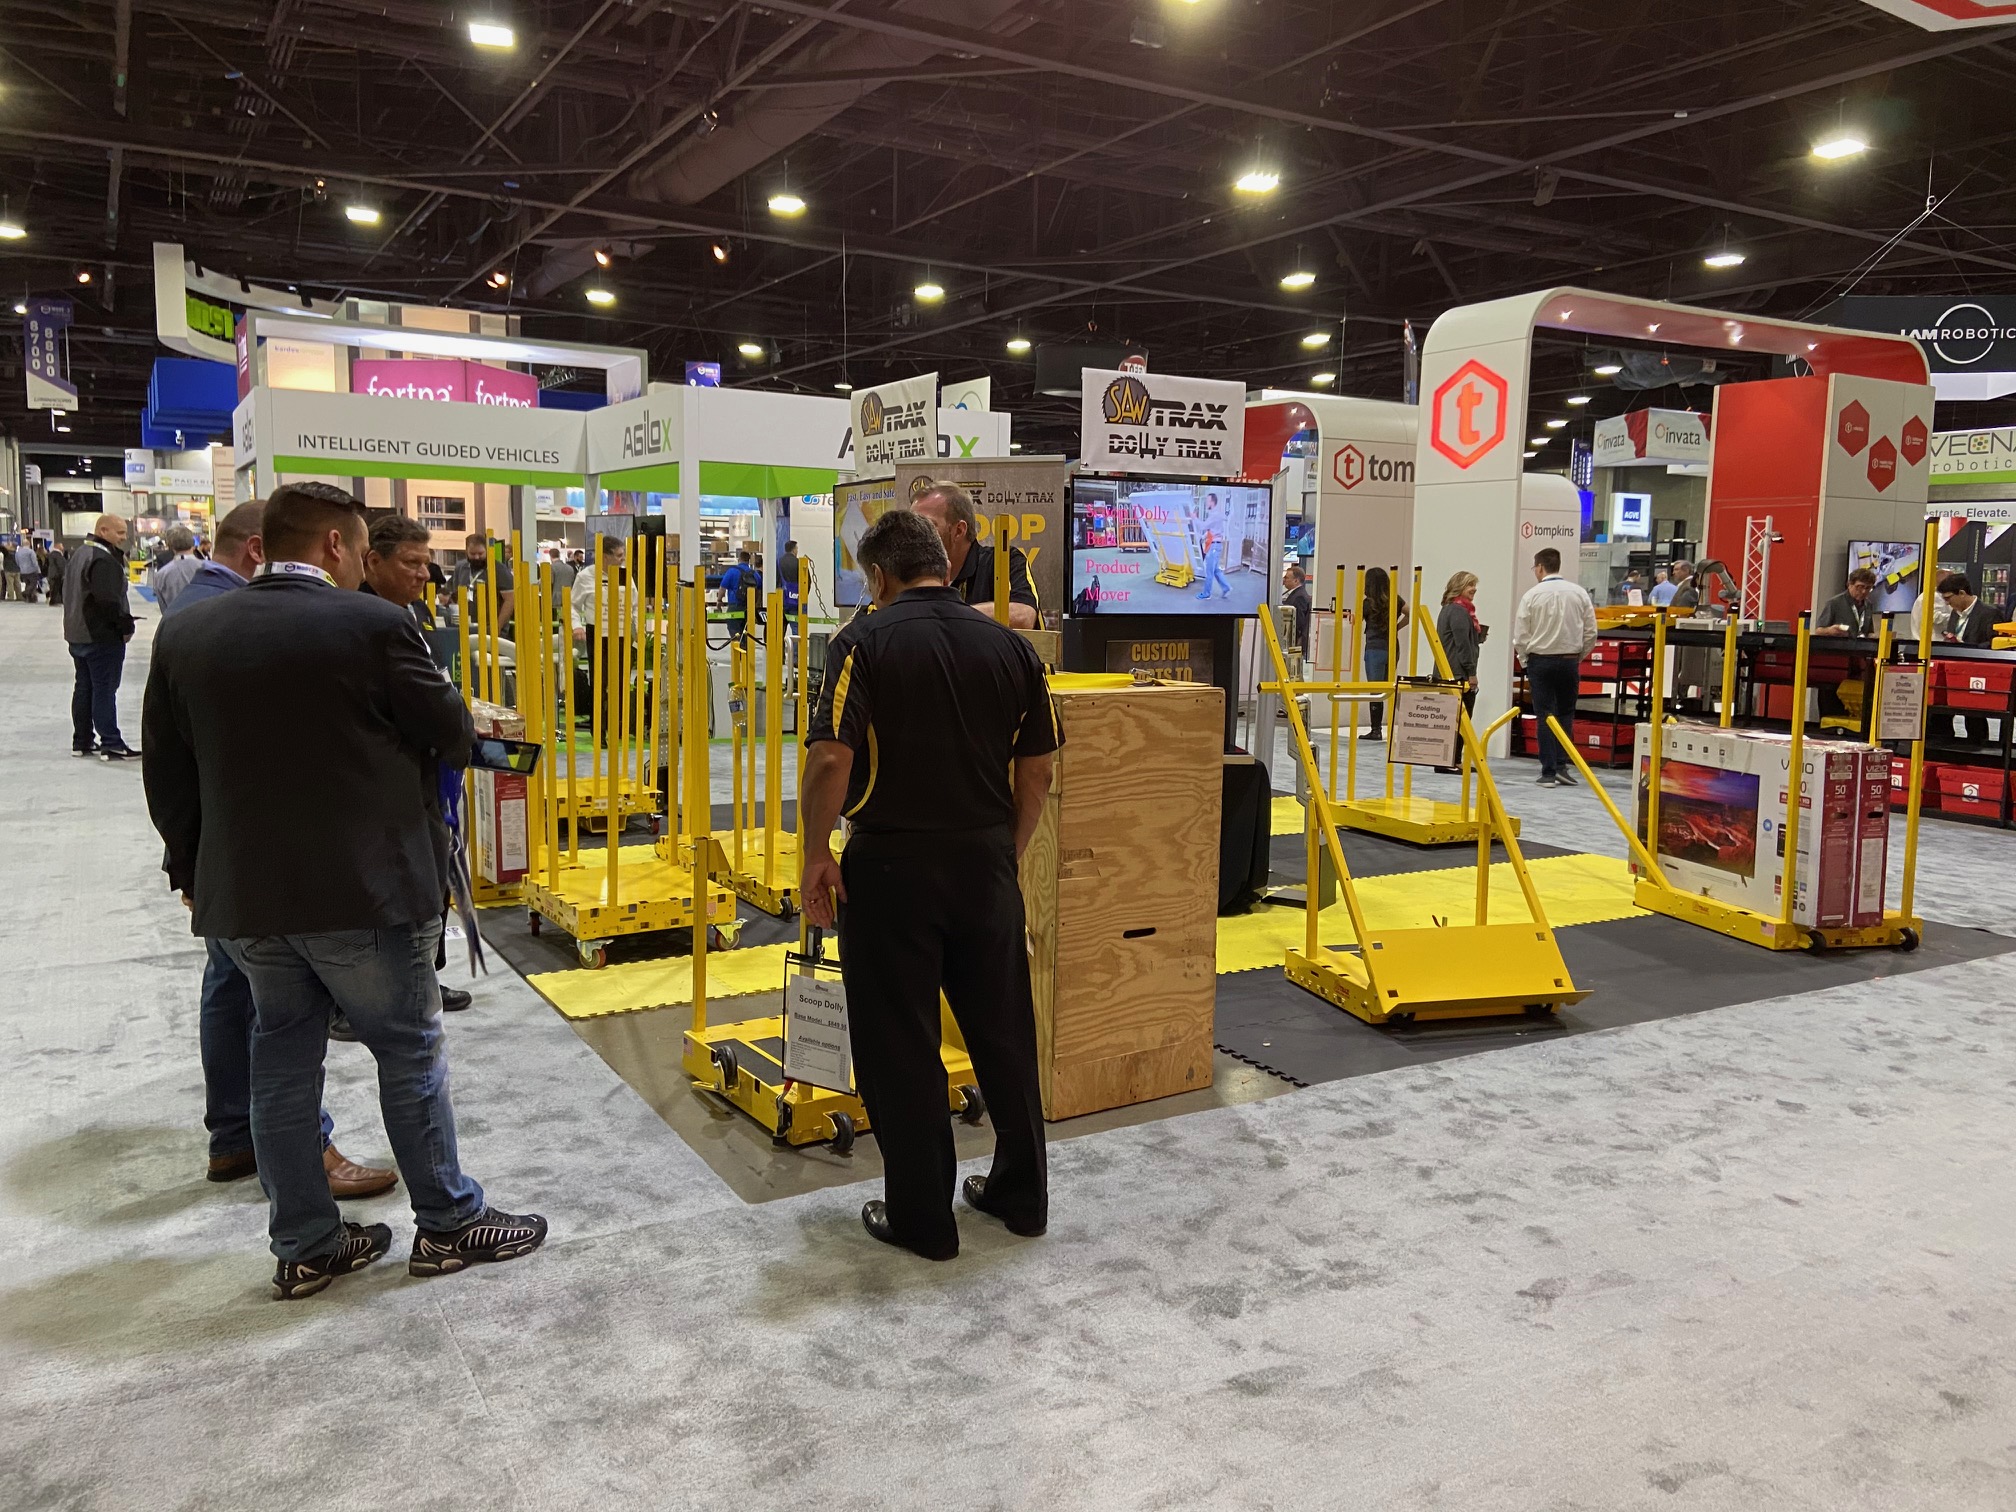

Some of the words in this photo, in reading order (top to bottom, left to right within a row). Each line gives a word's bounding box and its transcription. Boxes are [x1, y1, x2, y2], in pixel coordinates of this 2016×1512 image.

[1941, 328, 2016, 340] ROBOTIC
[30, 320, 41, 370] 8700
[44, 327, 55, 377] 8800
[1109, 380, 1147, 424] SAW
[1149, 399, 1229, 431] TRAX
[863, 397, 882, 435] SAW
[883, 400, 927, 432] TRAX
[1665, 428, 1701, 446] invata
[1931, 431, 2016, 457] VECN
[298, 434, 411, 455] INTELLIGENT
[416, 442, 481, 459] GUIDED
[486, 447, 560, 464] VEHICLES
[1109, 432, 1169, 460] DOLLY
[1175, 438, 1222, 460] TRAX
[1369, 454, 1415, 482] tom
[1932, 458, 2013, 473] robotic
[987, 490, 1021, 506] DOLLY
[1025, 492, 1055, 504] TRAX
[1133, 505, 1170, 524] Dolly
[1624, 511, 1640, 520] AGVE
[1966, 508, 2011, 518] Elevate.
[1534, 525, 1574, 539] tompkins
[1085, 559, 1141, 575] Product
[1085, 586, 1132, 602] Mover
[1131, 641, 1190, 662] CUSTOM
[1408, 712, 1429, 720] Scoop
[1416, 705, 1441, 713] Folding
[1781, 758, 1814, 774] VIO
[1835, 785, 1846, 795] 50
[1870, 785, 1882, 795] 50
[799, 994, 823, 1008] Scoop
[824, 1000, 844, 1013] Dolly
